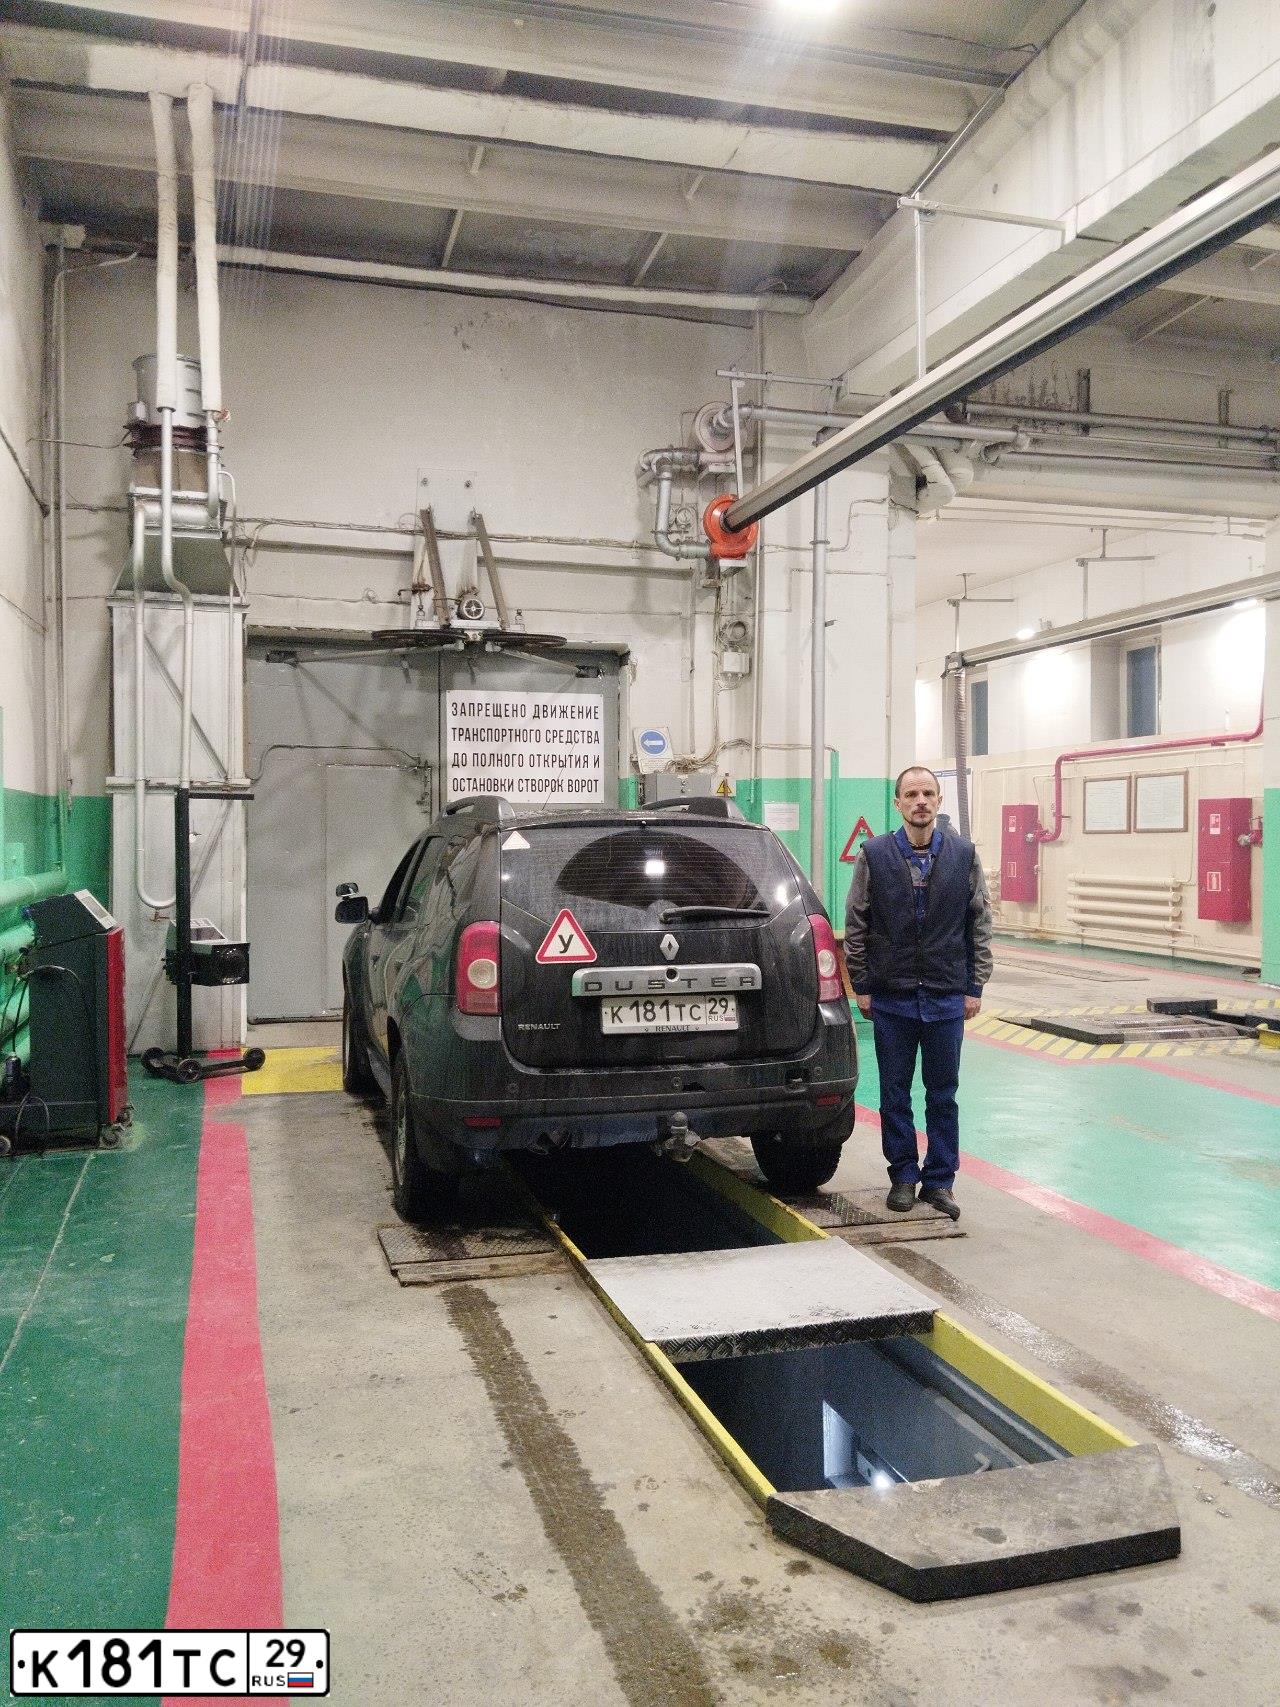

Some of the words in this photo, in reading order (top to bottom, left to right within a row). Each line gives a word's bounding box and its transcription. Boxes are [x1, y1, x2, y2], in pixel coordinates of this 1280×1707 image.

[451, 702, 526, 718] ЗАПРЕЩЕНО
[532, 705, 599, 720] ДВИЖЕНИЕ
[451, 727, 541, 743] ТРАНСПОРТНОГО
[545, 729, 600, 745] СРЕДСТВА
[451, 752, 467, 768] ДО
[472, 753, 524, 768] ПОЛНОГО
[529, 754, 589, 769] ОТКРЫТИЯ
[593, 755, 600, 769] И
[452, 777, 514, 792] ОСТАНОВКИ
[518, 778, 564, 793] СТВОРОК
[567, 779, 599, 793] ВОРОТ
[584, 976, 755, 992] DUSTER
[708, 997, 729, 1015] 29
[517, 1023, 561, 1031] RENAULT
